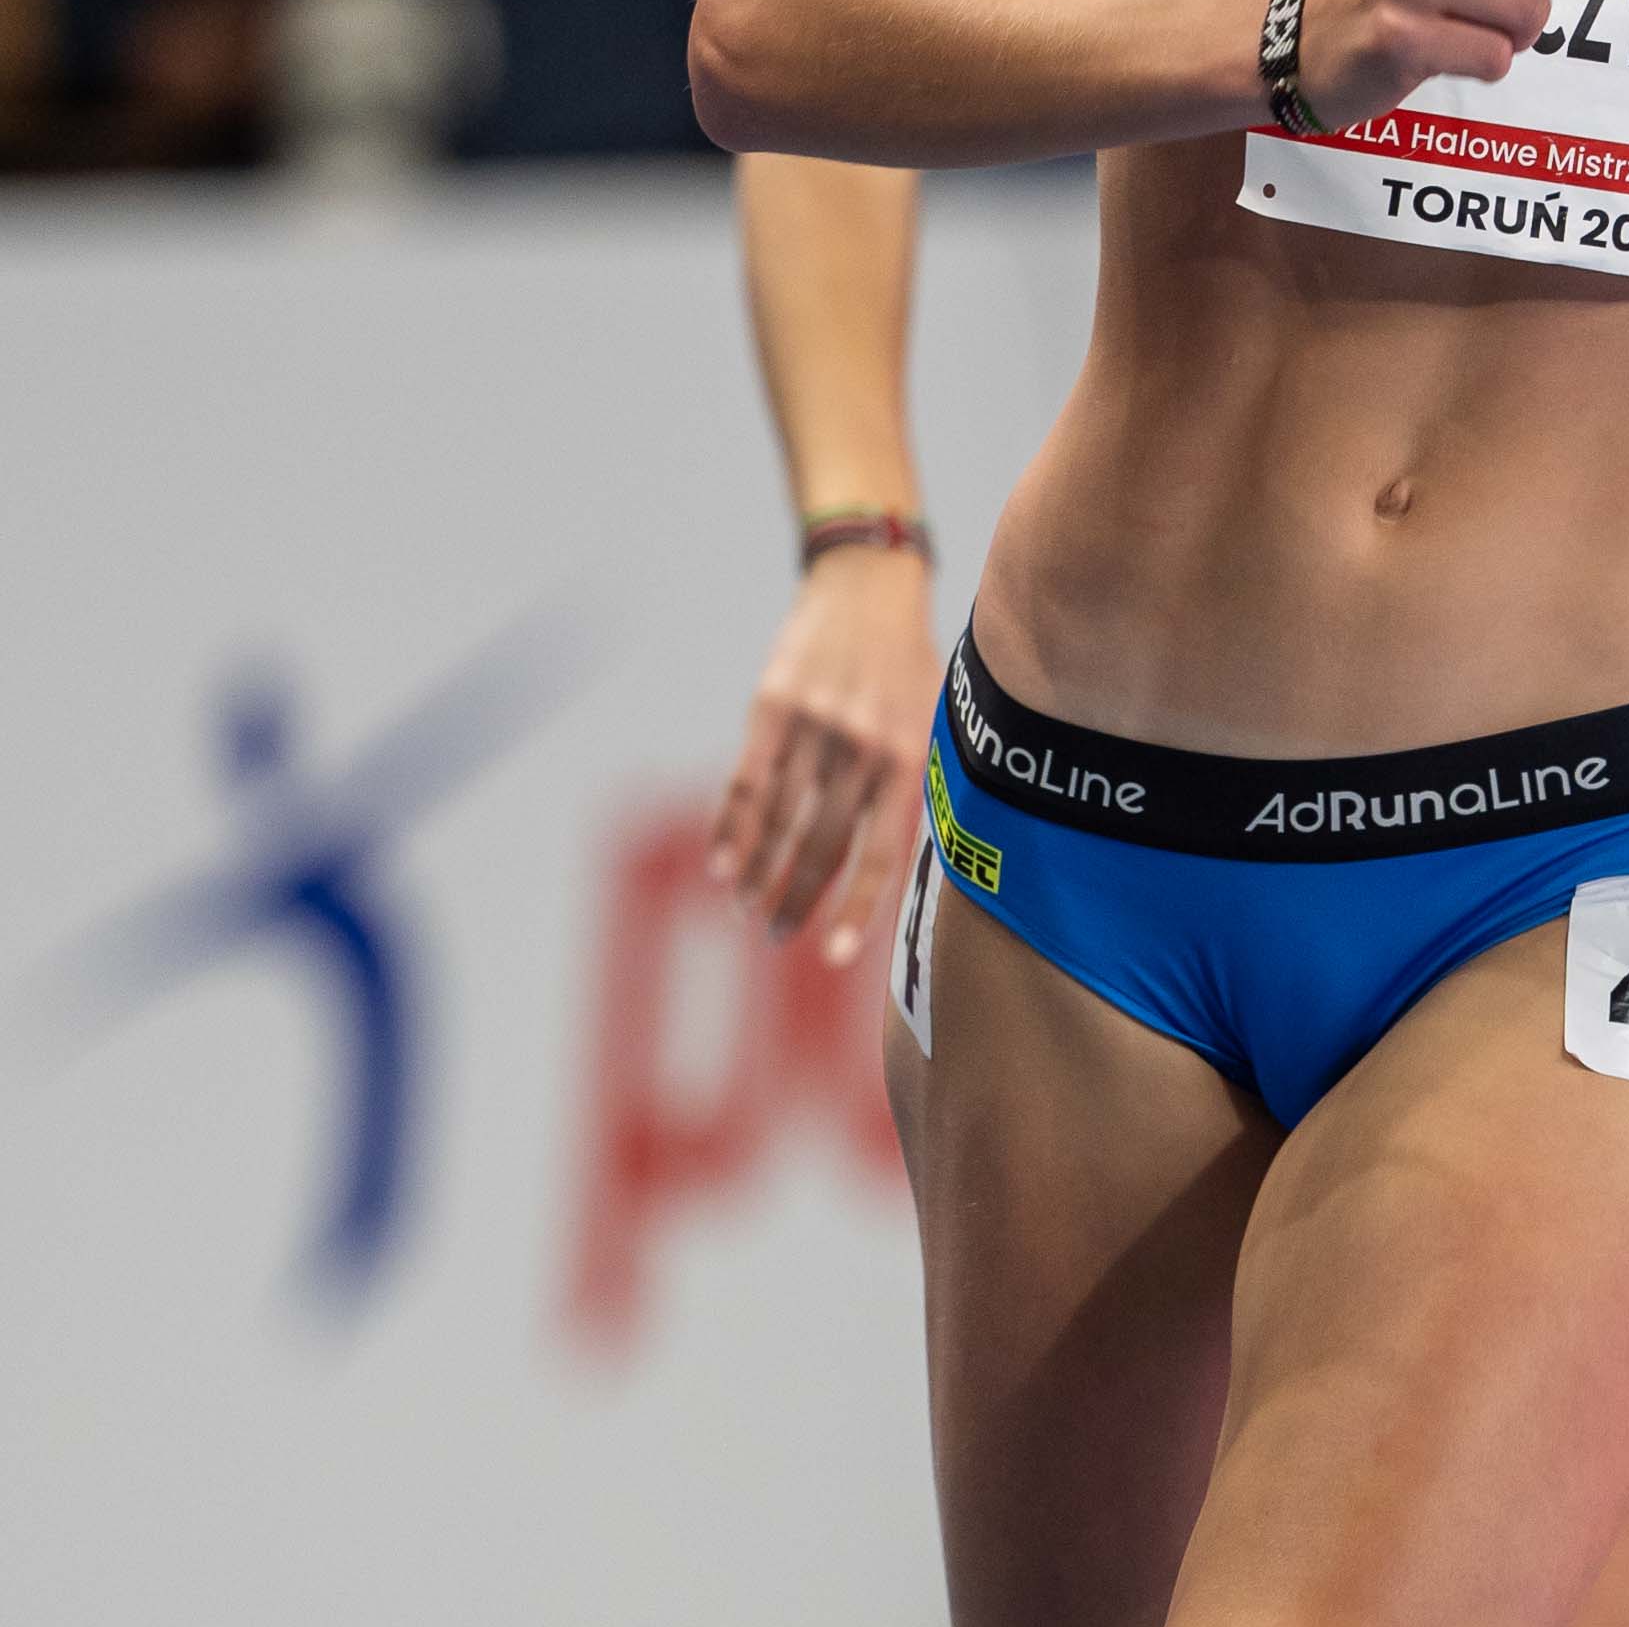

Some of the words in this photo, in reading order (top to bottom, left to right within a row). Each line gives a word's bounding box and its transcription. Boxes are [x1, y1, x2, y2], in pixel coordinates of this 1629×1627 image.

[1334, 118, 1400, 148] ZLA
[1410, 123, 1539, 168] Halowe
[1381, 177, 1568, 244] TORUŃ
[1245, 756, 1611, 835] AdRunaLine
